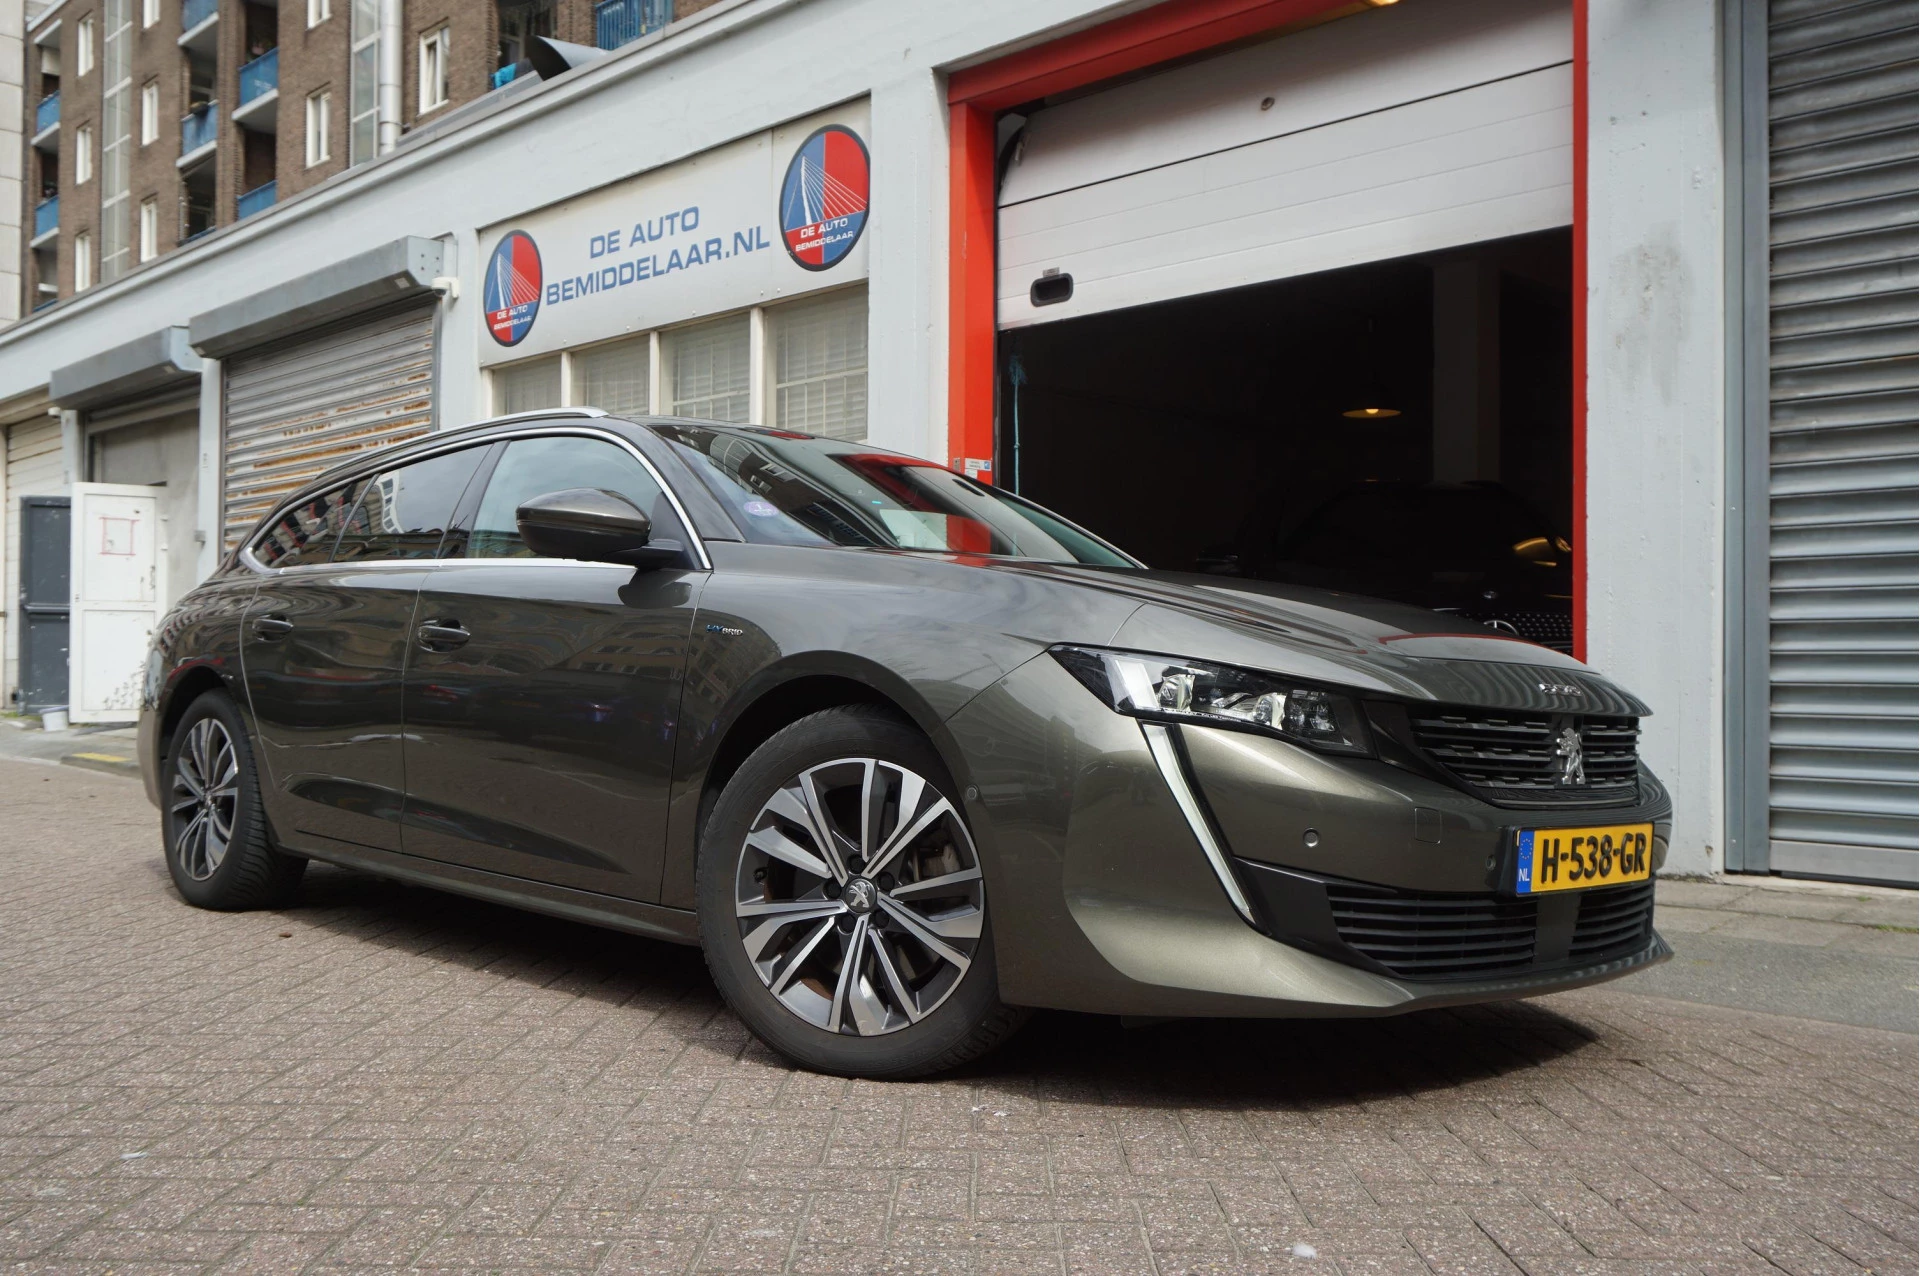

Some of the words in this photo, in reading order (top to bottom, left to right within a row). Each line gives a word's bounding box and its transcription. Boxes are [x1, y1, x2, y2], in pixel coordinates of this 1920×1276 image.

[590, 229, 621, 259] DE
[628, 206, 699, 248] AUTO
[800, 226, 816, 239] DE
[818, 217, 848, 234] AUTO
[795, 230, 854, 252] BEMIDDELAAR
[546, 225, 770, 305] BEMIDDELAAR.NL
[496, 310, 508, 320] DE
[508, 304, 528, 317] AUTO
[1541, 832, 1647, 884] H-538-GR
[1518, 867, 1530, 882] NL
